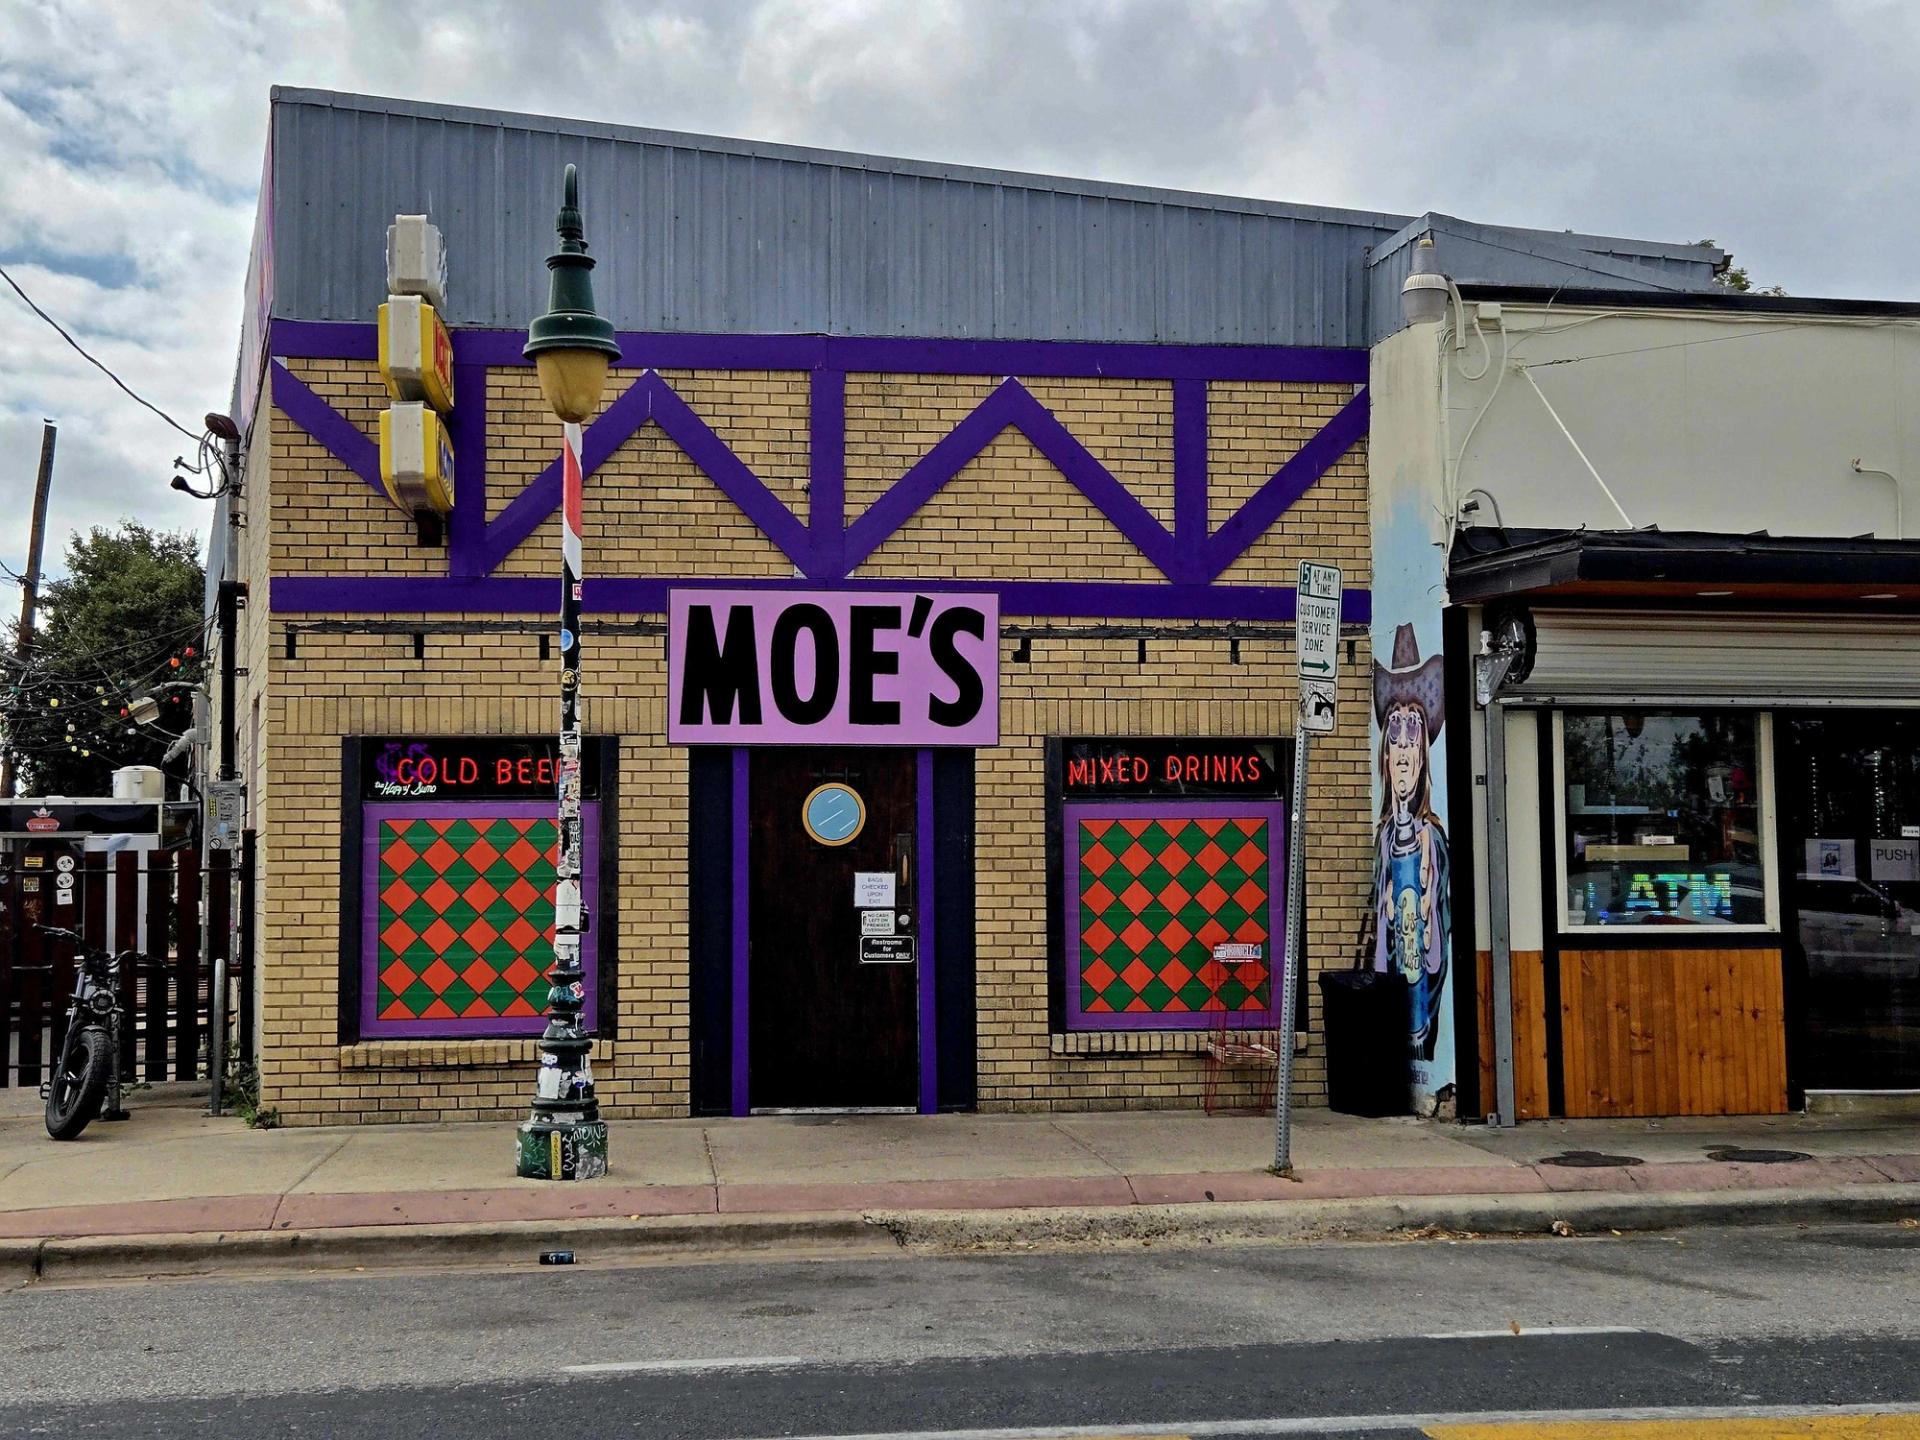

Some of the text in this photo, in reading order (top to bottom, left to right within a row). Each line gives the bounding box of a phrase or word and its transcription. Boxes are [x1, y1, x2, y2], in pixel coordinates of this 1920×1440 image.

[1301, 563, 1310, 584] 15
[1323, 570, 1336, 582] ANY
[1317, 583, 1332, 595] TIME
[1300, 603, 1336, 620] CUSTOMER
[1301, 620, 1331, 636] SERVICE
[1304, 637, 1324, 652] ZONE
[679, 594, 985, 727] MOE'S
[397, 757, 479, 785] COLD
[1068, 755, 1261, 786] MIXED DRINKS
[1876, 848, 1914, 861] PUSH
[1623, 873, 1733, 916] ATM
